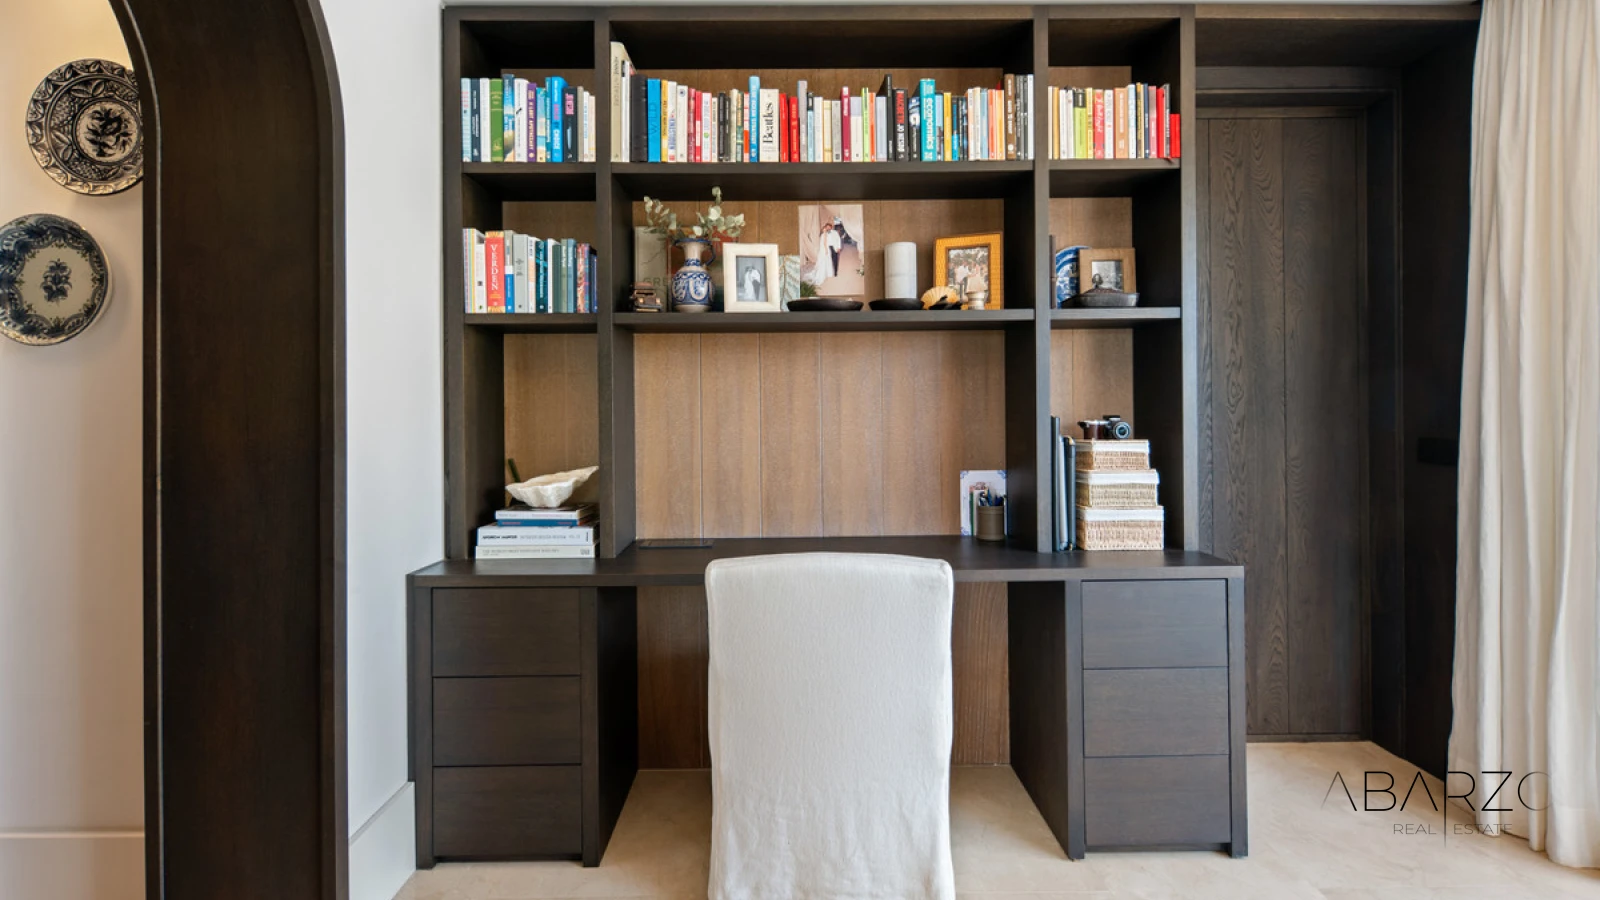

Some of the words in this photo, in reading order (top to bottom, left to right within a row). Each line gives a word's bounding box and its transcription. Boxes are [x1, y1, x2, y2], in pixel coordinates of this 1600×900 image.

[648, 102, 658, 135] WILD
[763, 102, 774, 143] Beatles
[926, 98, 935, 150] economics
[490, 244, 499, 290] VERDEN
